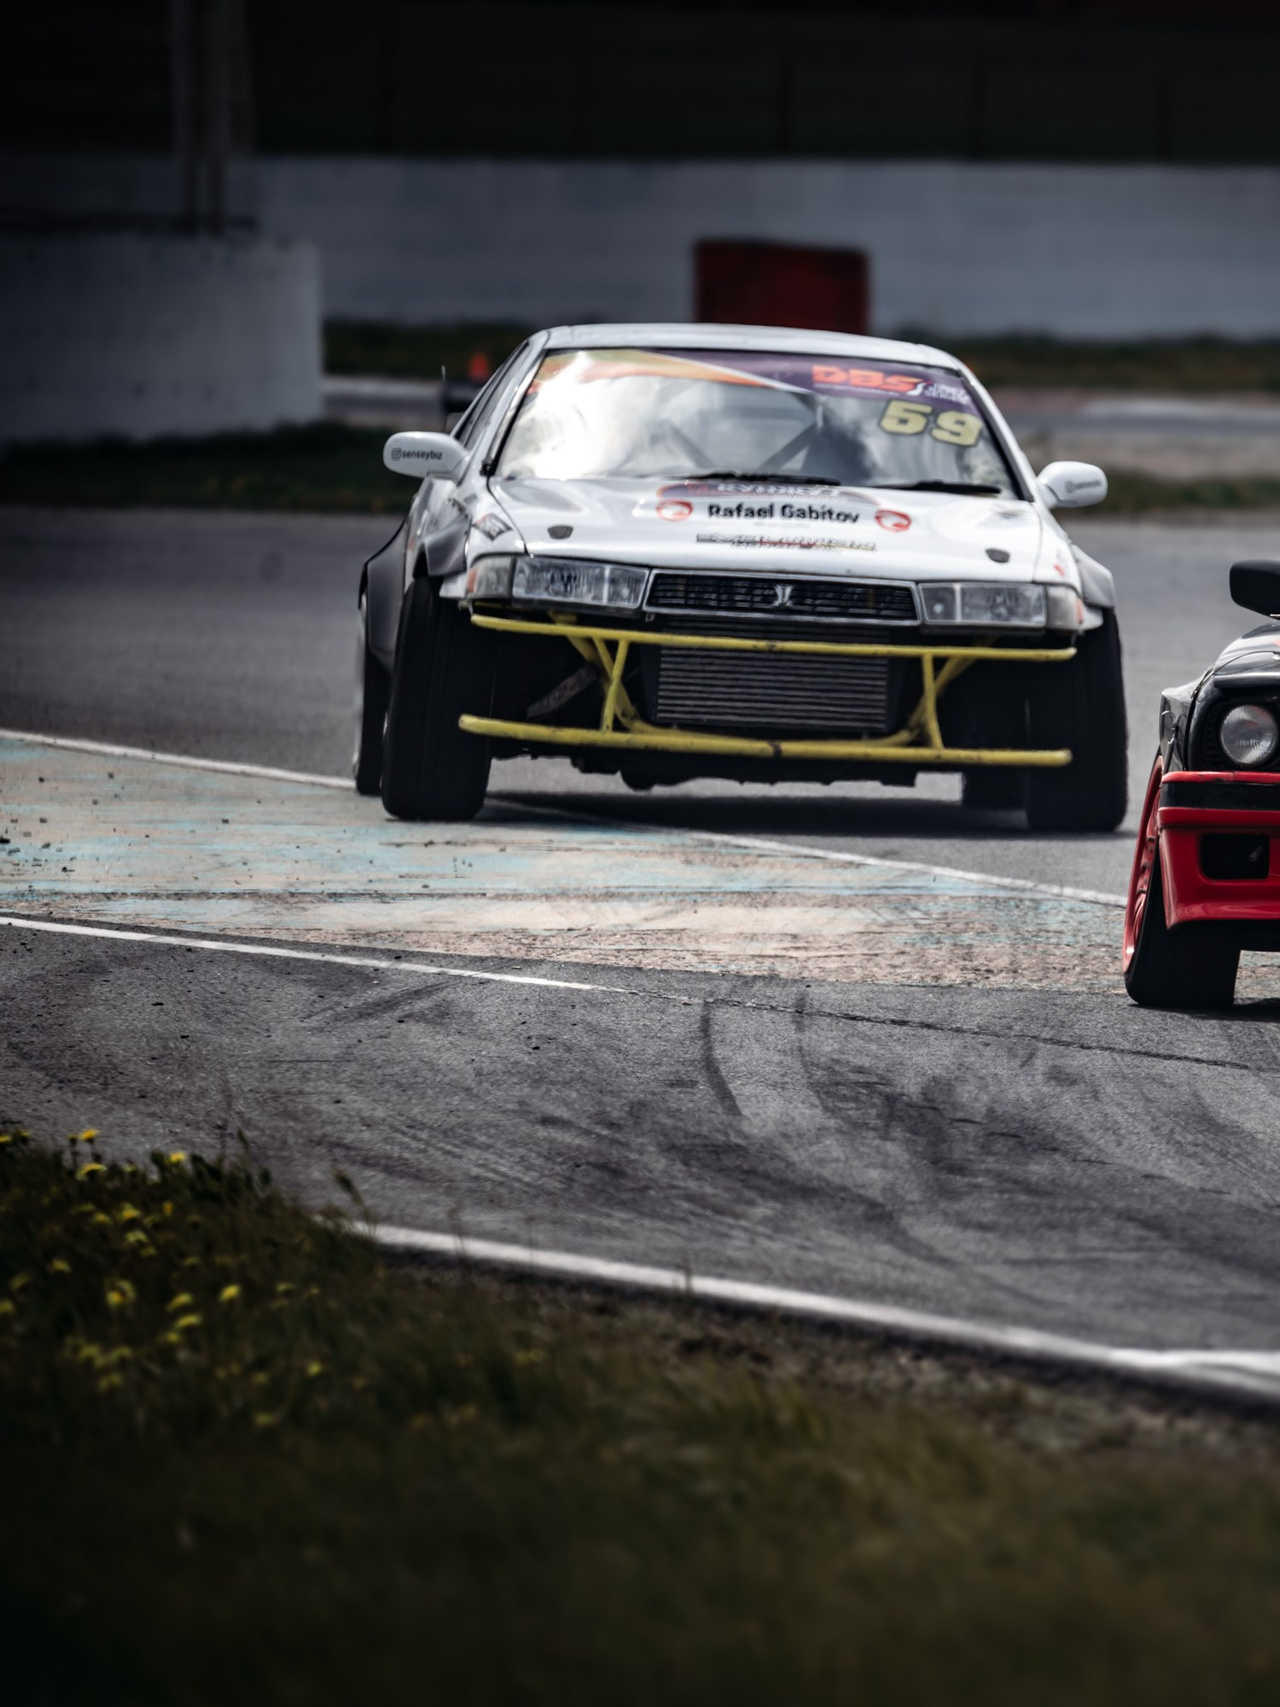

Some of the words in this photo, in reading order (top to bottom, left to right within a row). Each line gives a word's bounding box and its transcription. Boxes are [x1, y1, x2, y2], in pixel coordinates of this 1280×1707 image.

[878, 399, 984, 447] 59
[708, 501, 774, 519] Rafael
[780, 503, 860, 523] Gabitov
